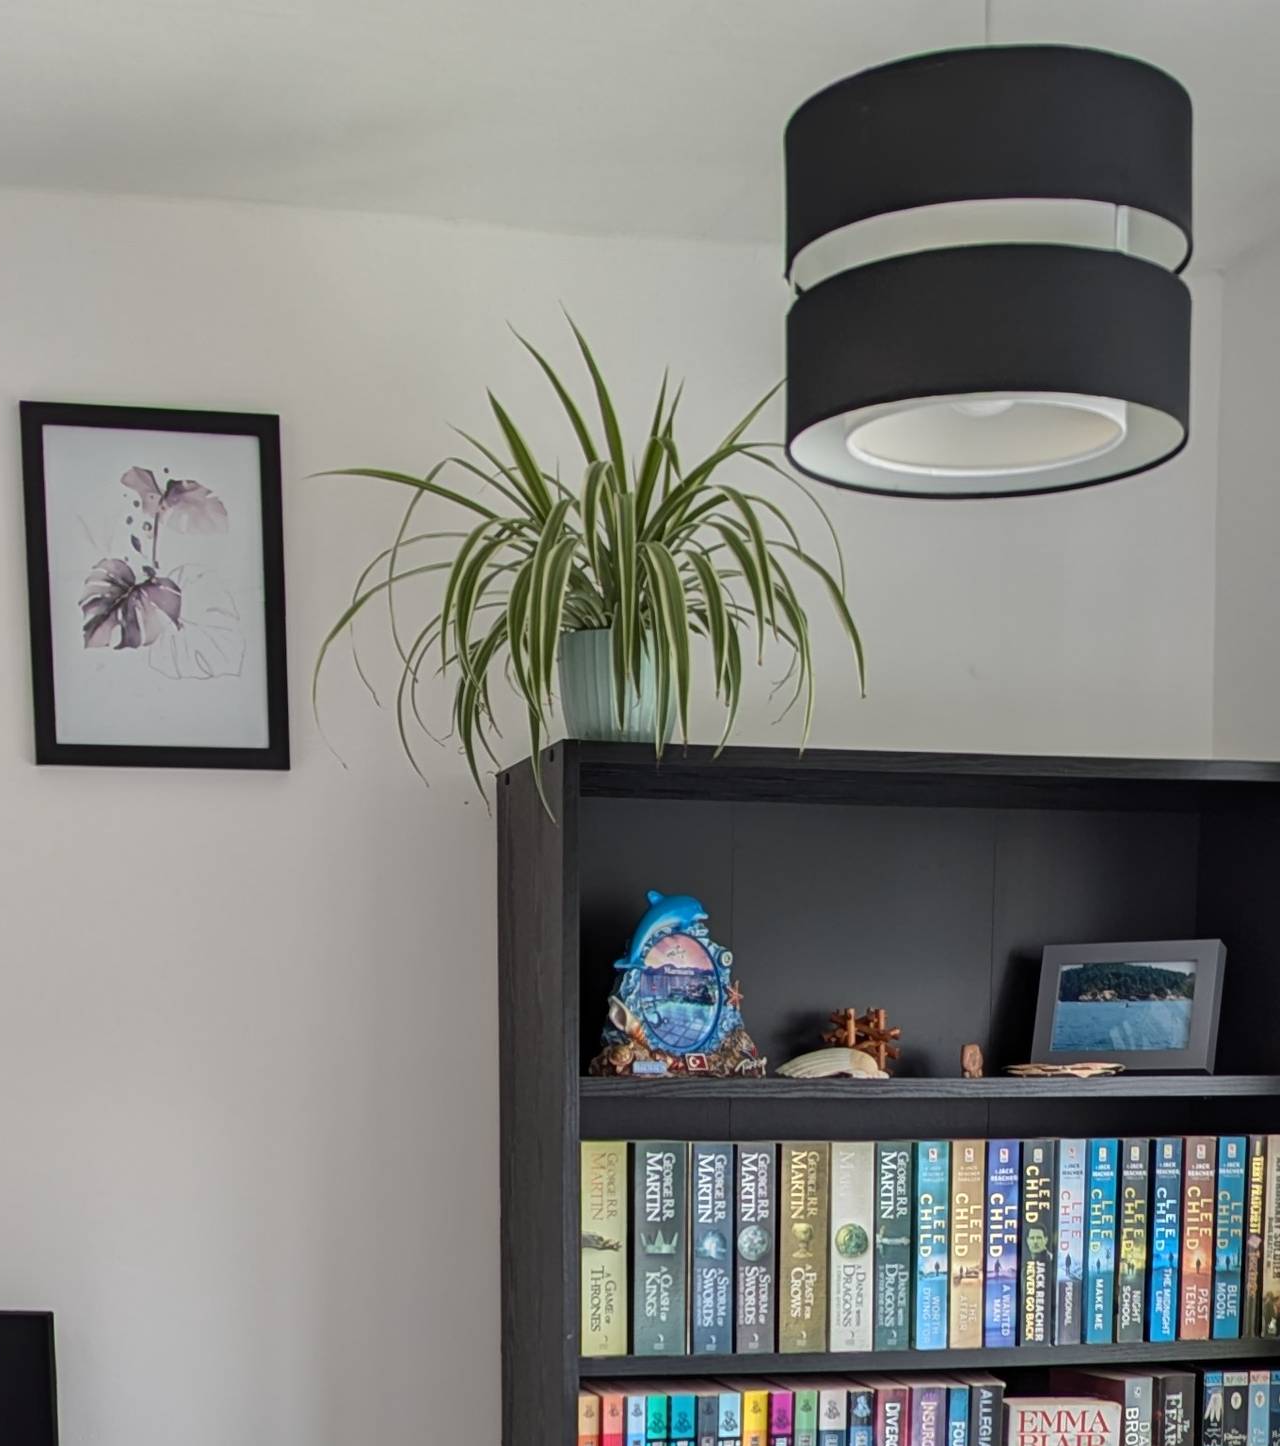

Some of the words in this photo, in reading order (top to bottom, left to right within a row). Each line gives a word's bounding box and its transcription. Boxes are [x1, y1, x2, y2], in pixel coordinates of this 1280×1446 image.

[590, 1152, 607, 1221] MARTIN
[645, 1152, 662, 1222] MARTIN
[697, 1153, 714, 1223] MARTIN
[740, 1152, 757, 1222] MARTIN
[791, 1151, 807, 1219] MARTIN
[881, 1151, 897, 1219] MARTIN
[1026, 1166, 1039, 1223] CHILD
[1038, 1178, 1050, 1210] LEE
[920, 1194, 933, 1258] CHILD
[933, 1206, 944, 1244] LEE
[955, 1193, 969, 1256] CHILD
[969, 1205, 981, 1244] LEE
[990, 1193, 1003, 1257] CHILD
[1004, 1205, 1016, 1244] LEE
[1060, 1191, 1071, 1252] CHILD
[1071, 1202, 1081, 1239] LEE
[1090, 1189, 1102, 1253] CHILD
[1102, 1200, 1112, 1239] LEE
[1123, 1187, 1135, 1251] CHILD
[1134, 1200, 1144, 1238] LEE
[1155, 1187, 1167, 1251] CHILD
[1166, 1200, 1176, 1238] LEE
[1187, 1187, 1201, 1250] CHILD
[1200, 1199, 1212, 1236] LEE
[1218, 1191, 1230, 1249] CHILD
[1231, 1202, 1242, 1236] LEE
[645, 1272, 660, 1317] KINGS
[659, 1274, 672, 1311] CLASH
[758, 1275, 771, 1314] STORM
[790, 1267, 805, 1317] CROWS
[803, 1272, 817, 1305] FEAST
[854, 1272, 866, 1307] DANCE
[897, 1271, 909, 1306] DANCE
[1026, 1261, 1035, 1293] NEVER
[1035, 1262, 1045, 1288] JACK
[1095, 1278, 1103, 1308] MAKE
[1163, 1268, 1172, 1286] THE
[590, 1266, 604, 1332] THRONES
[604, 1280, 616, 1312] GAME
[702, 1268, 717, 1327] SWORDS
[716, 1277, 729, 1315] STORM
[744, 1266, 758, 1325] SWORDS
[842, 1264, 855, 1327] DRAGONS
[884, 1264, 898, 1327] DRAGONS
[992, 1299, 1001, 1323] MAN
[1026, 1296, 1034, 1311] GO
[1064, 1282, 1073, 1326] PERSONAL
[1121, 1286, 1132, 1328] SCHOOL
[1132, 1291, 1141, 1324] NIGHT
[1155, 1291, 1163, 1313] LINE
[1162, 1288, 1172, 1334] MIDNIGHT
[1185, 1286, 1197, 1325] TENSE
[1197, 1288, 1209, 1320] PAST
[1216, 1282, 1227, 1319] MOON
[1226, 1285, 1237, 1317] BLUE
[1000, 1295, 1010, 1336] WANTED
[1025, 1315, 1035, 1341] BACK
[1035, 1291, 1044, 1341] REACHER
[1095, 1313, 1103, 1330] ME
[1018, 1410, 1110, 1433] EMMA
